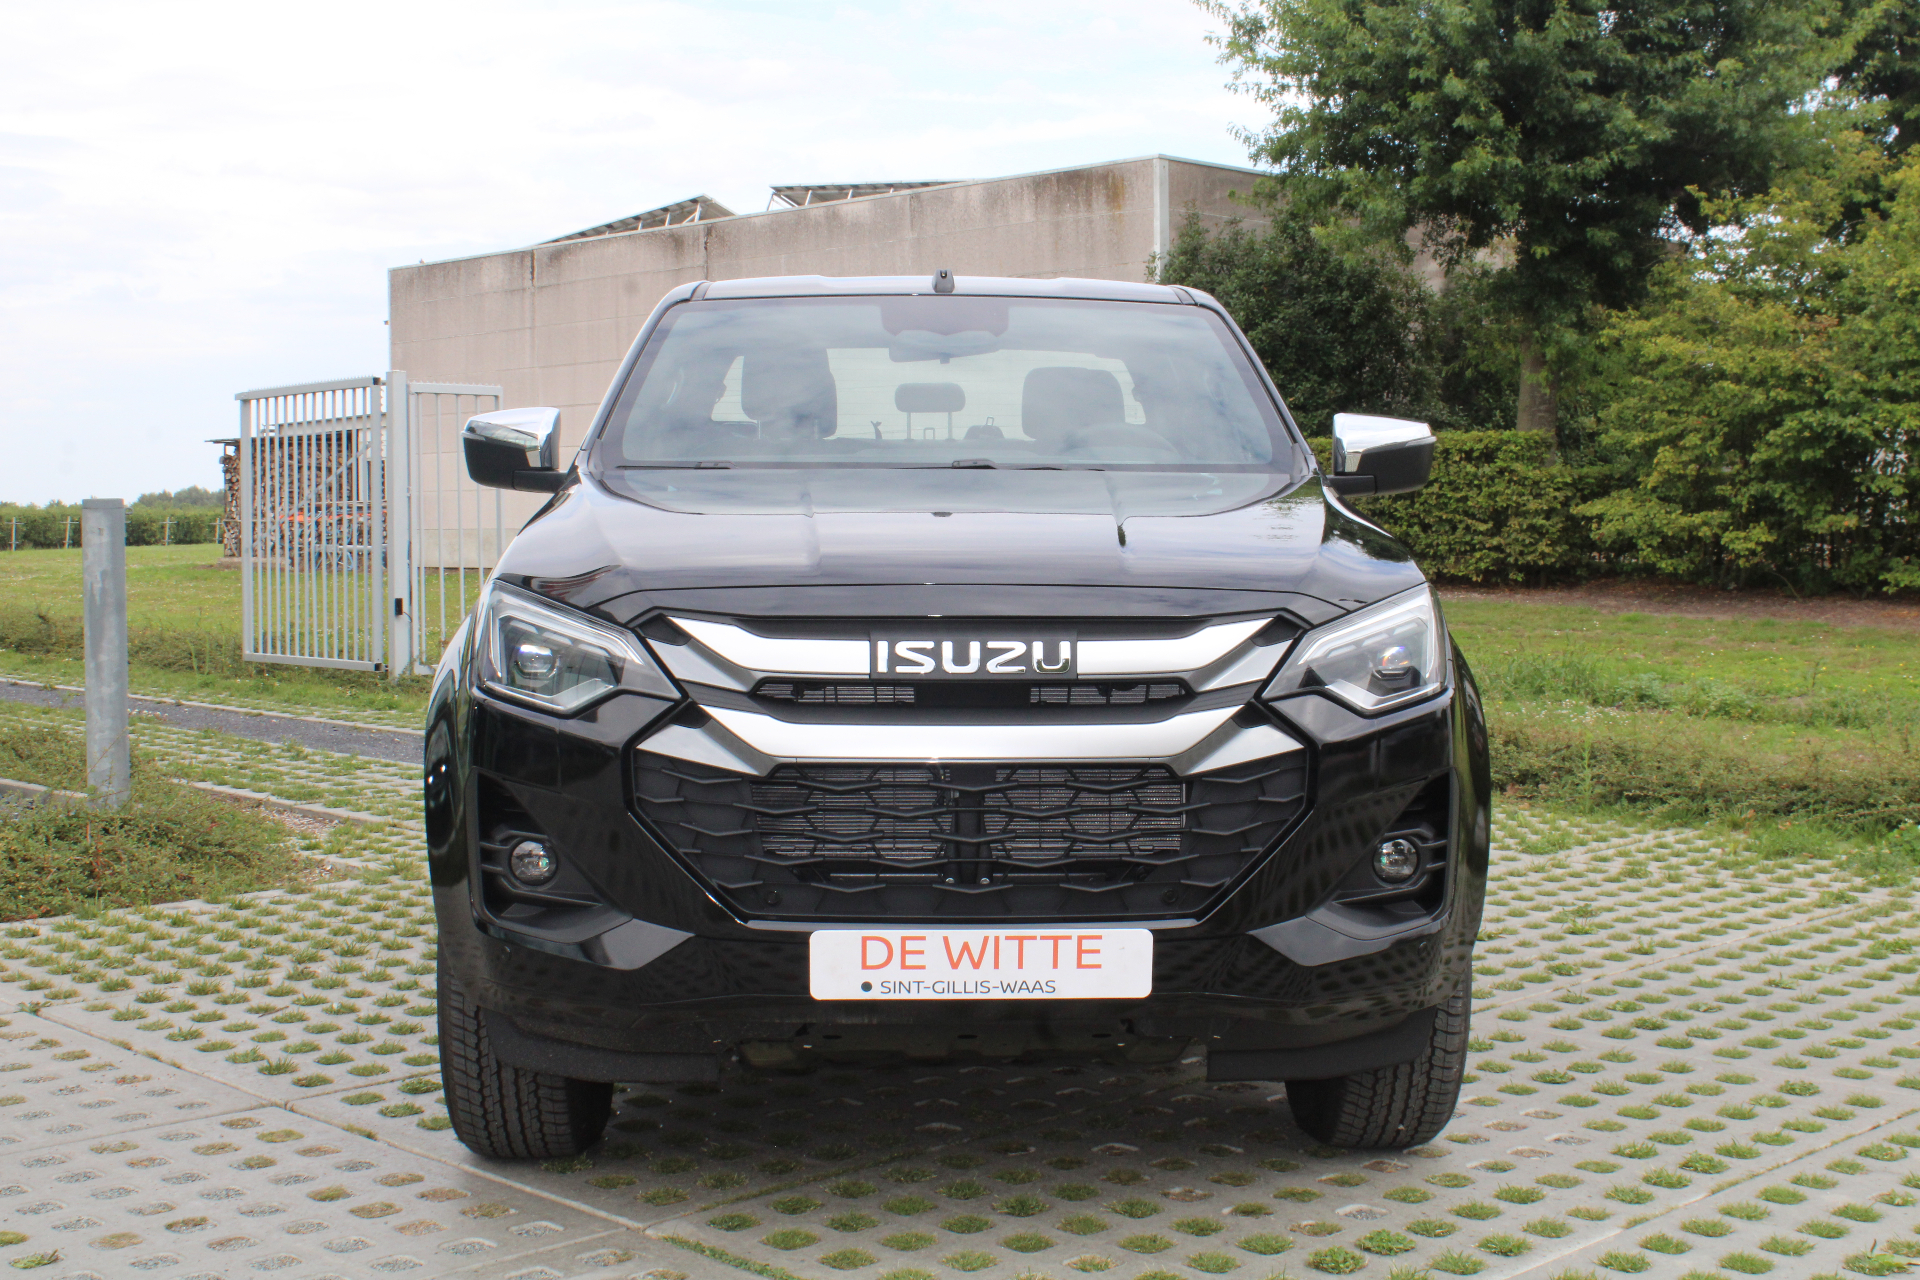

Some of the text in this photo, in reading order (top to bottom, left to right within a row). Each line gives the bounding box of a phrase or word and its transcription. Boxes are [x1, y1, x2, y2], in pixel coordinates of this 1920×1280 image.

[877, 640, 1071, 674] ISUZU
[860, 934, 1103, 970] DE WITTE
[880, 980, 1057, 995] SINT-GILLIS-WAAS
